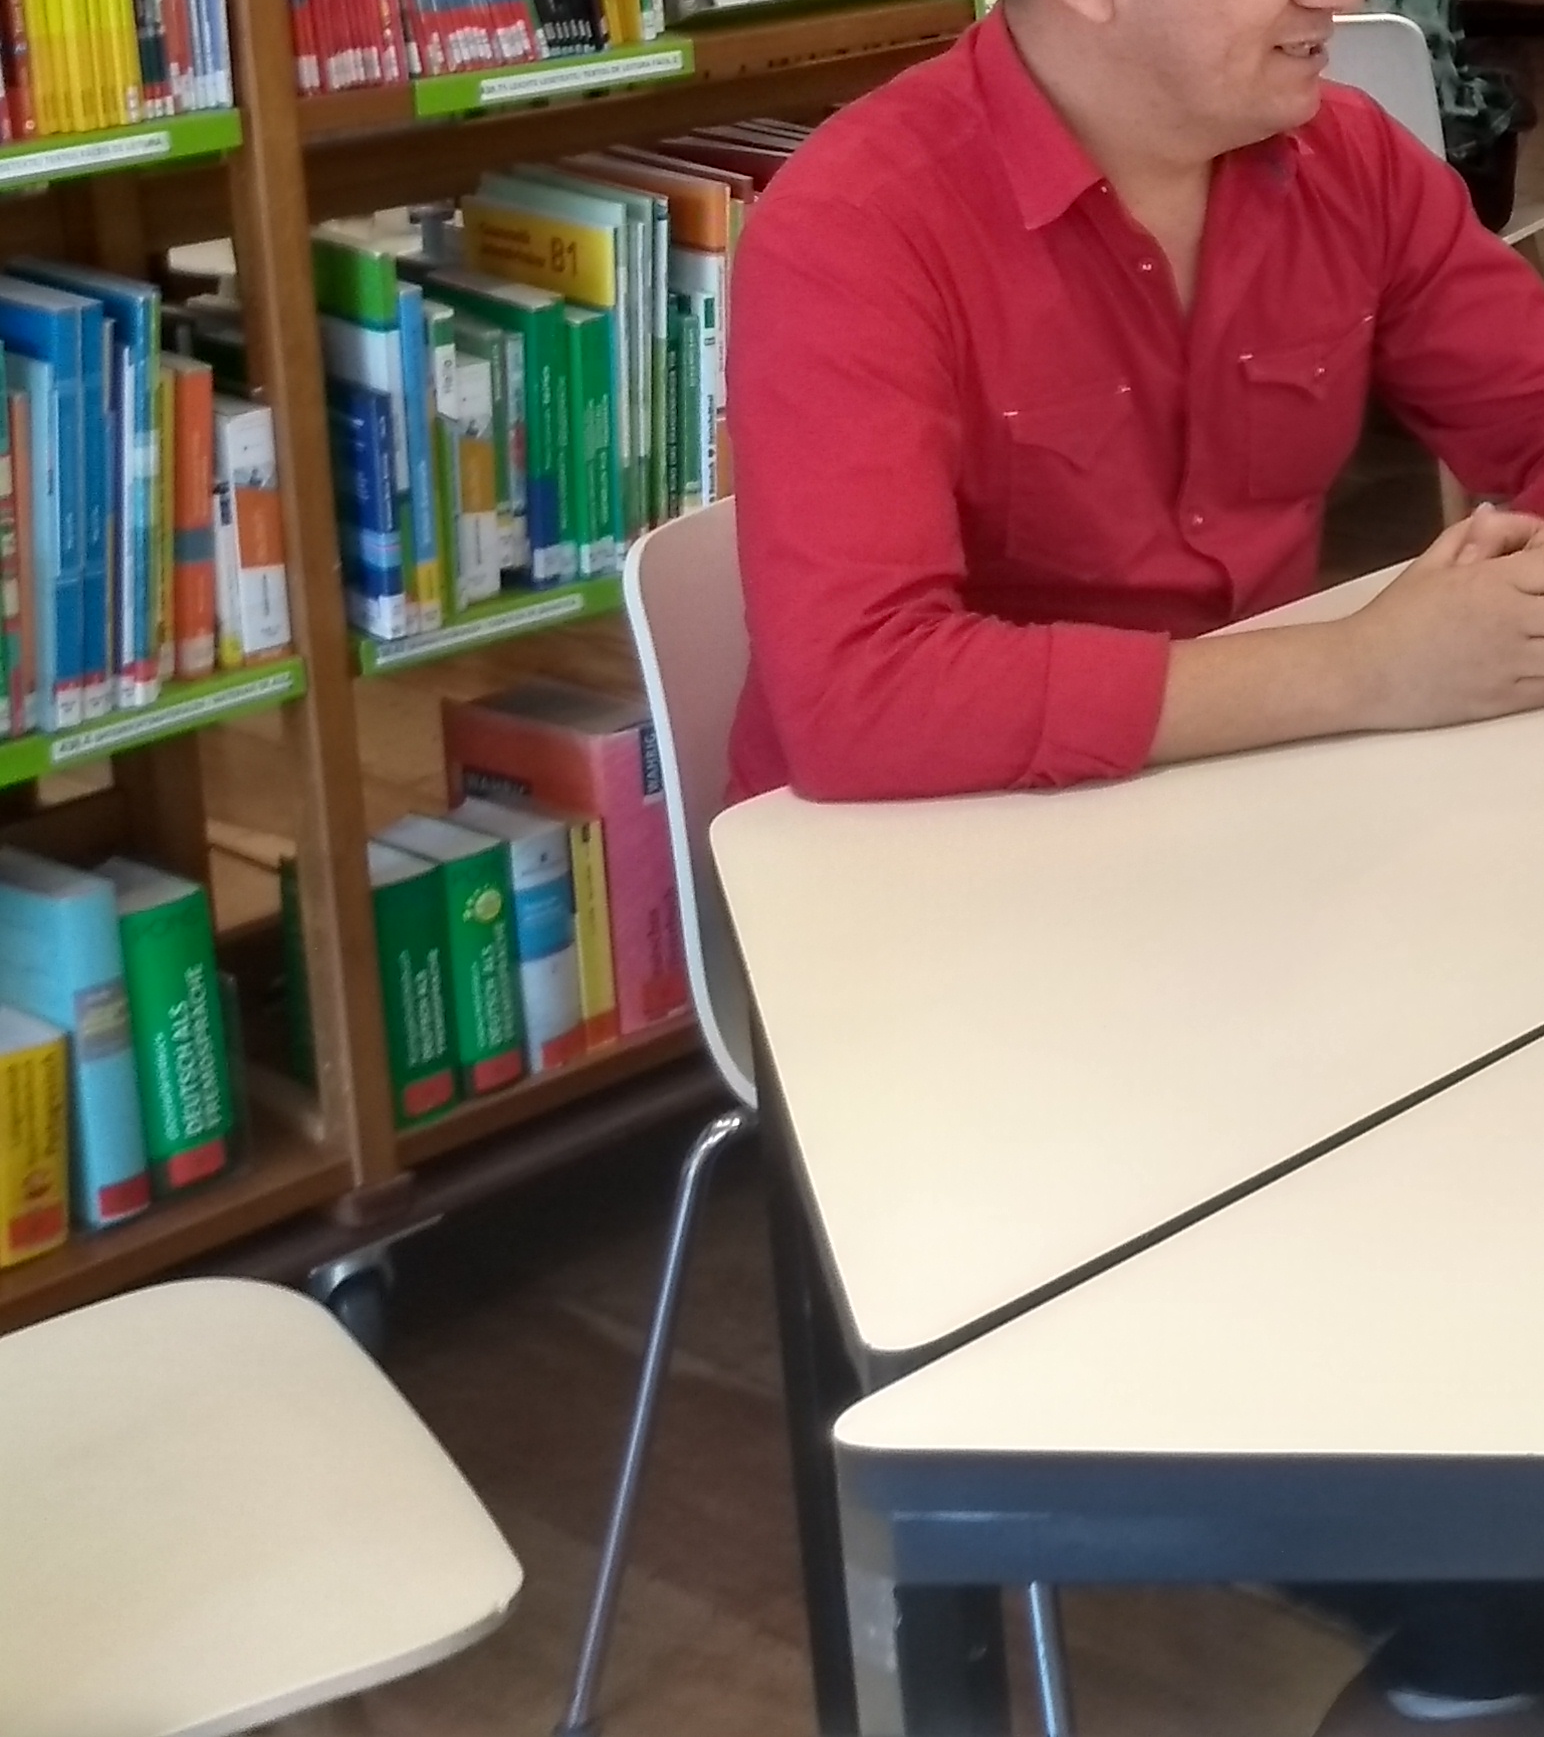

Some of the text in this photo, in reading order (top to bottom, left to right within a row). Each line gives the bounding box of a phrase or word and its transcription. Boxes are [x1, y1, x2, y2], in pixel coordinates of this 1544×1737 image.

[644, 732, 662, 794] WAHRIG
[168, 1000, 203, 1138] DEUTSCH ALS
